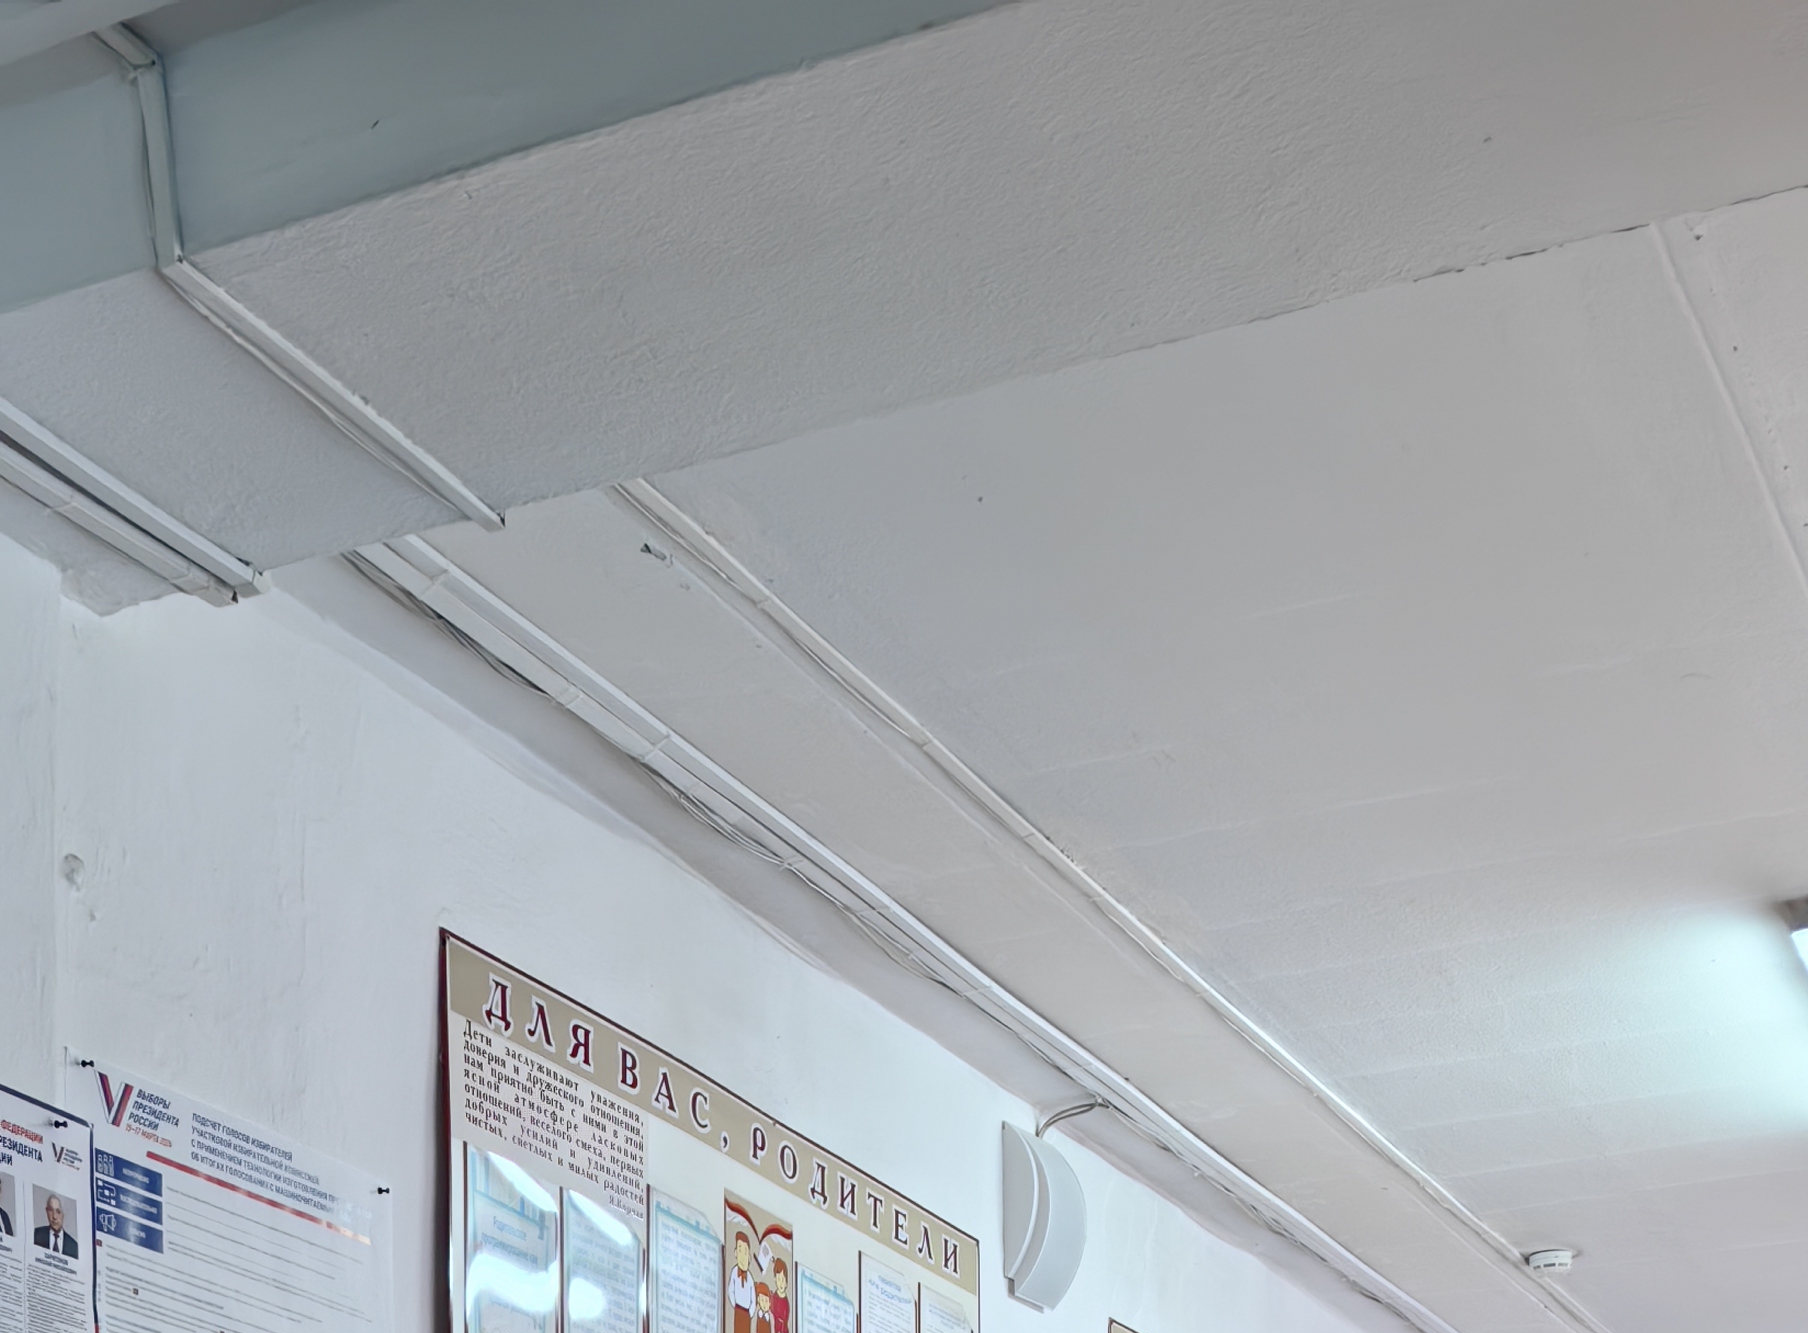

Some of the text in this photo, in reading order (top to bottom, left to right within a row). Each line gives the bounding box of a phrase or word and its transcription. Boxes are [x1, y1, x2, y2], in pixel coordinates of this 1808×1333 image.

[128, 1111, 160, 1131] РОССИИ
[132, 1100, 180, 1128] ПРЕЗИДЕНТА
[136, 1088, 171, 1110] ВЫБОРЫ
[463, 1018, 645, 1127] Дети заслуживают уважения,
[463, 1039, 645, 1139] доверия и дружеского отношения,
[463, 1053, 484, 1072] нам
[490, 1066, 534, 1097] приятно
[540, 1089, 565, 1112] быть
[582, 1113, 607, 1133] ними
[623, 1133, 644, 1152] этой
[463, 1067, 644, 1166] ясной атмосфере ласковых
[464, 1082, 644, 1179] отношений, веселого смеха, первых
[464, 1097, 645, 1193] добрых усилий и удивлений,
[464, 1111, 644, 1206] чистых, светлых и милых радостей
[485, 978, 960, 1275] ДЛЯ ВАС, РОДИТЕЛИ
